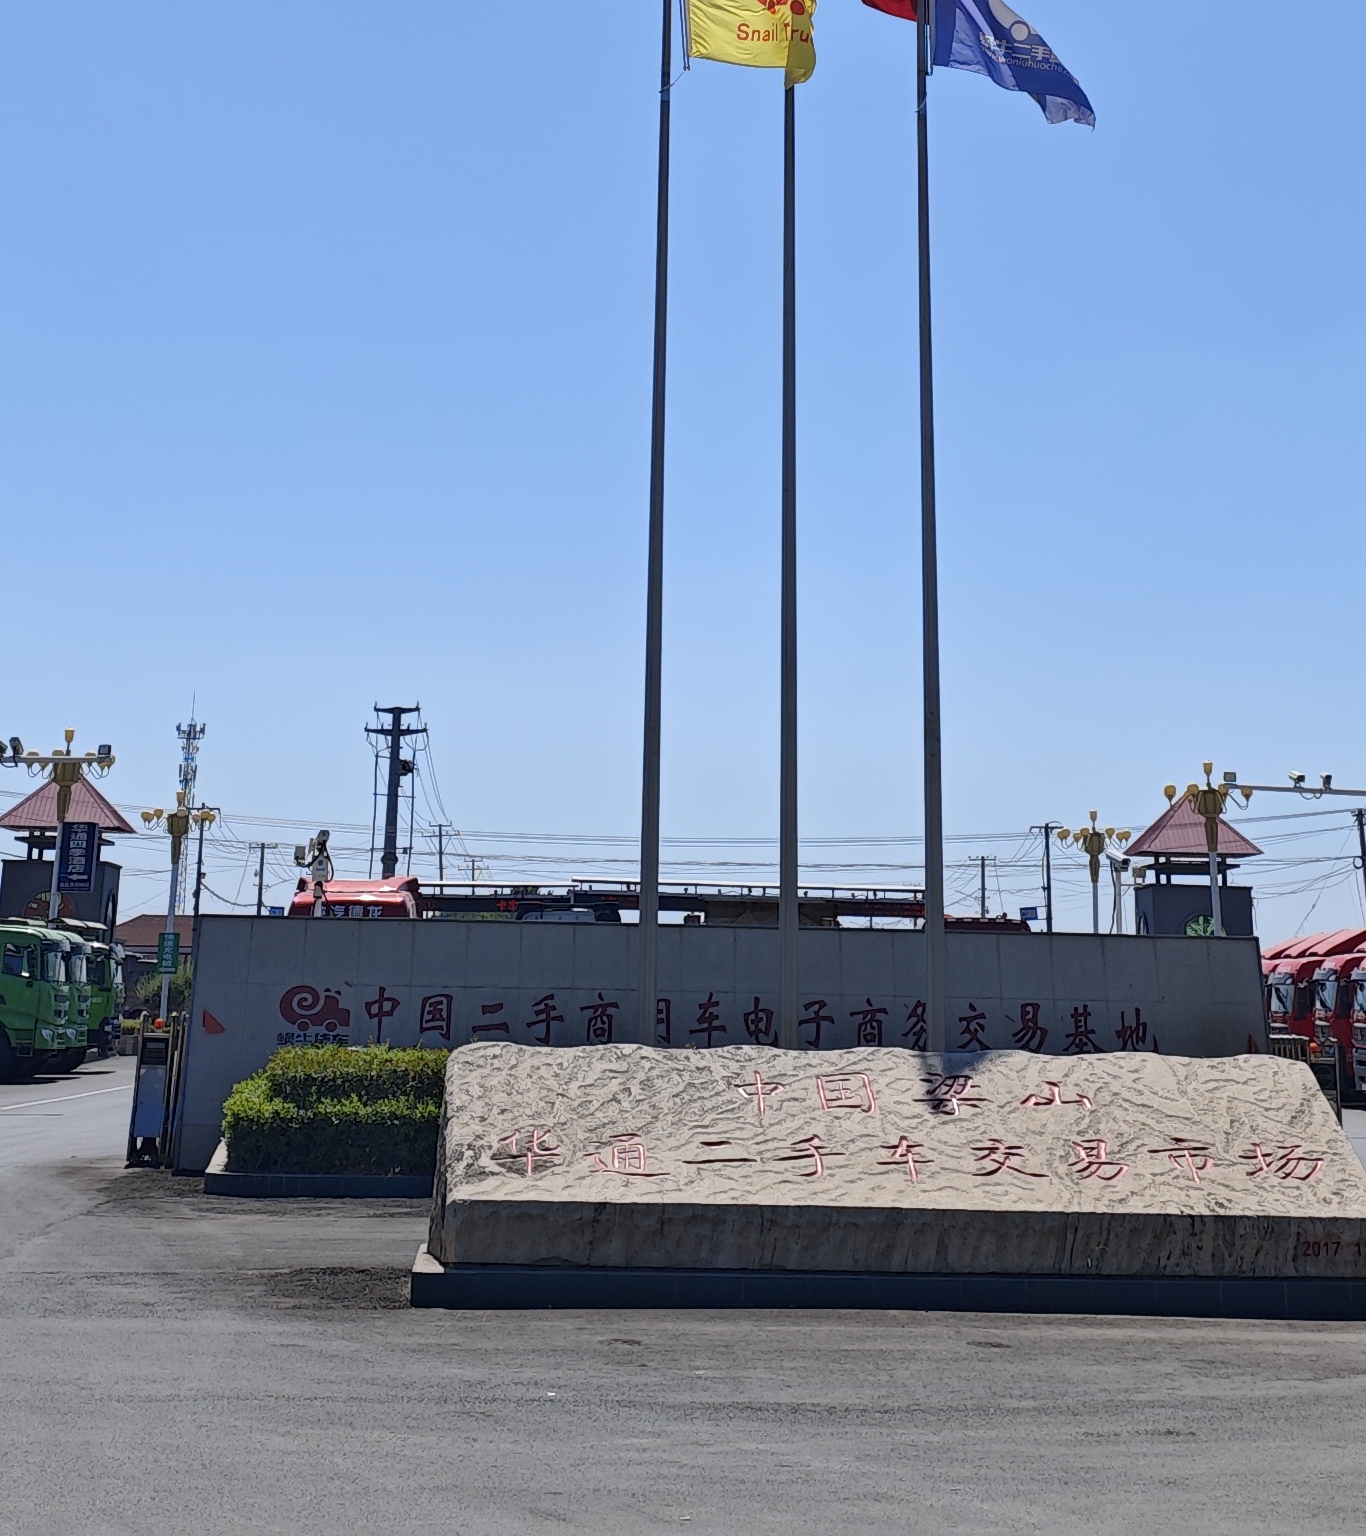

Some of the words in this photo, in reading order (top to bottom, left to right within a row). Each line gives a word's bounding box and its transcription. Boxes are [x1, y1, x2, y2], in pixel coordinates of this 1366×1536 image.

[737, 22, 778, 43] Snail
[782, 21, 810, 44] Tru
[364, 986, 1160, 1055] 中国二手商用车电子商务交易基地
[734, 1069, 1093, 1117] 中国梁山
[490, 1130, 1326, 1184] 华通二手车交易市场
[1301, 1240, 1341, 1258] 2017
